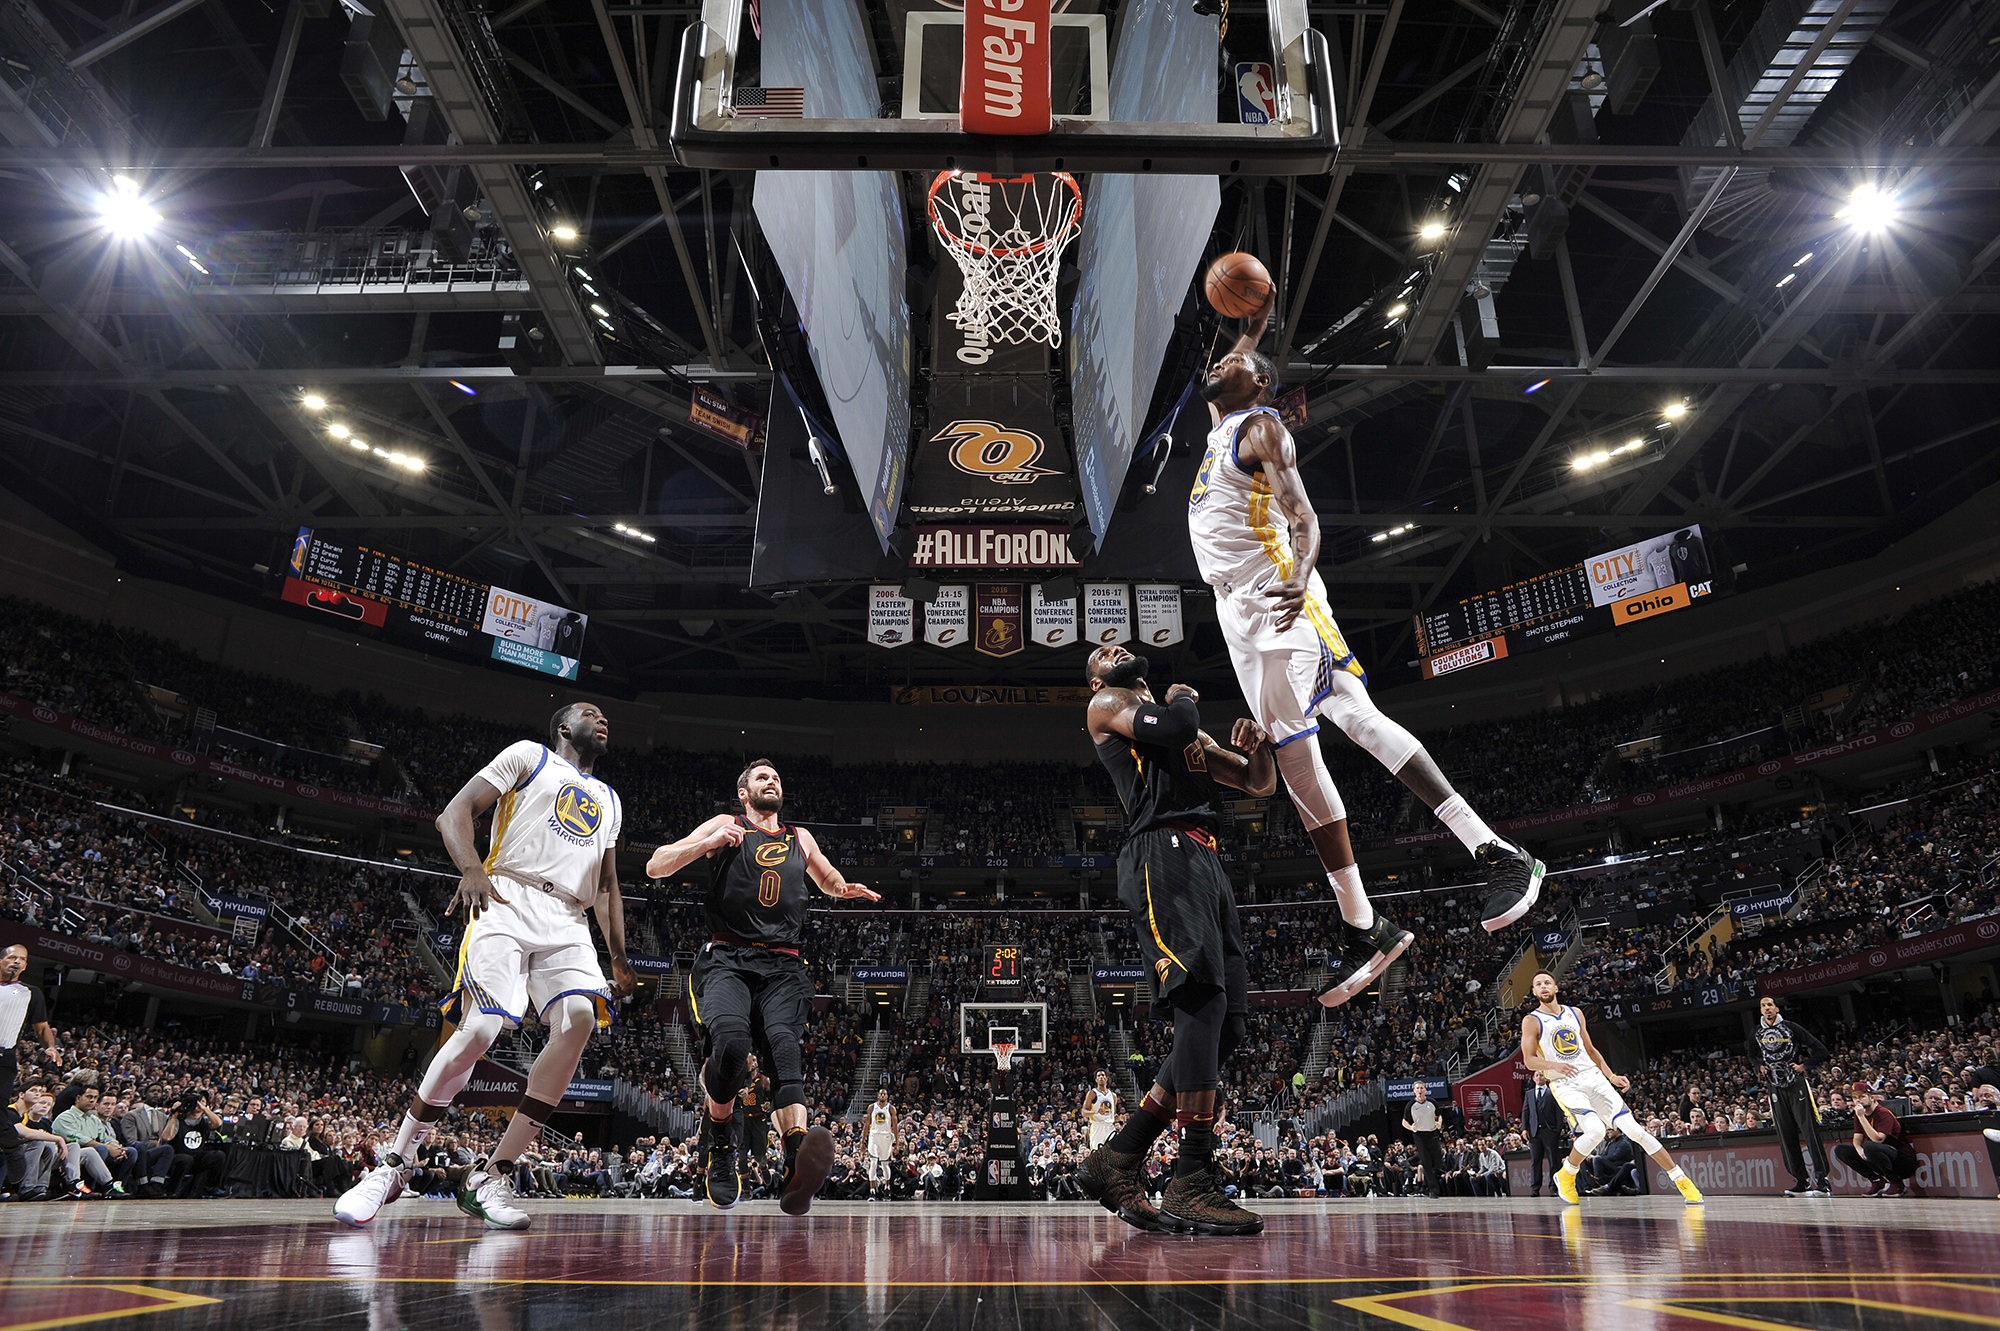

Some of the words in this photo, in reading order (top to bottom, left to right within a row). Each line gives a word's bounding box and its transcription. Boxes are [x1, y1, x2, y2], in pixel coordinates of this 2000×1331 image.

[1245, 112, 1264, 123] NBA
[695, 408, 711, 421] TEAM
[712, 417, 731, 430] SWISH
[996, 473, 1031, 482] The
[961, 498, 1027, 506] Arena
[910, 506, 975, 514] Loans
[982, 502, 1076, 514] Quicken
[323, 542, 344, 554] Durant
[322, 549, 340, 560] Green
[320, 556, 337, 567] Curry
[318, 562, 343, 575] Iguodala
[1592, 552, 1634, 584] CITY
[316, 568, 336, 580] McCaw
[305, 574, 320, 584] TEAM
[320, 578, 341, 590] TOTALS
[1602, 576, 1638, 592] COLLECTION
[990, 586, 1008, 594] 2016
[1092, 588, 1122, 596] 2016-17
[1689, 581, 1712, 598] CAT
[992, 598, 1006, 606] NBA
[1093, 599, 1122, 607] EASTERN
[1139, 594, 1178, 602] CHAMPIONS
[492, 594, 533, 623] CITY
[1039, 600, 1068, 608] EASTERN
[1626, 596, 1674, 616] Ohio
[870, 609, 912, 618] CONFERENCE
[926, 609, 966, 618] CONFERENCE
[980, 605, 1019, 615] CHAMPIONS
[1034, 608, 1074, 616] CONFERENCE
[1087, 608, 1128, 616] CONFERENCE
[410, 615, 434, 628] SHOTS
[436, 623, 469, 637] STEPHEN
[494, 618, 526, 632] COLLECTION
[872, 618, 910, 626] CHAMPIONS
[928, 618, 965, 626] CHAMPIONS
[1036, 616, 1073, 626] CHAMPIONS
[1089, 616, 1126, 625] CHAMPIONS
[1525, 628, 1549, 638] SHOTS
[1550, 615, 1584, 630] STEPHEN
[424, 630, 450, 643] CURRY.
[1544, 631, 1571, 643] CURRY.
[500, 640, 522, 653] BUILD
[523, 646, 544, 658] MORE
[1432, 642, 1487, 667] COUNTERTOP
[498, 646, 517, 658] THAN
[518, 651, 544, 666] MUSCLE
[1438, 652, 1483, 672] SOLUTIONS
[930, 688, 1050, 705] LOUDVILLE
[1928, 710, 1951, 725] Visit
[1952, 701, 1976, 718] Your
[70, 719, 156, 755] kiadealers.com
[208, 761, 285, 789] SORENTO
[332, 792, 352, 804] Visit
[356, 796, 375, 809] Your
[378, 802, 401, 814] Local
[403, 806, 417, 817] Kia
[1394, 832, 1456, 845] SORENT
[1508, 818, 1526, 830] Visit
[1528, 814, 1548, 828] Your
[1550, 809, 1573, 822] Local
[1575, 807, 1589, 817] Kia
[1591, 801, 1620, 815] Dealer
[1668, 771, 1745, 799] kiadealers.com
[1794, 734, 1877, 764] SORENTO
[579, 797, 598, 817] 23
[548, 816, 594, 848] WARRIORS
[1370, 840, 1389, 848] Final
[1241, 852, 1248, 860] 6
[1283, 850, 1294, 858] PM
[840, 858, 858, 867] FG%
[863, 858, 875, 866] 65
[920, 857, 934, 868] 34
[960, 858, 971, 867] 21
[986, 858, 1008, 867] 2:02
[1081, 858, 1095, 868] 29
[758, 869, 781, 908] 0
[224, 901, 266, 916] HYUNDAI
[1750, 896, 1793, 911] HYUNDAI
[1542, 942, 1567, 950] HYUNDAI
[995, 948, 1017, 959] 2:02
[37, 936, 104, 962] SORENTO
[140, 962, 155, 977] Visit
[157, 966, 172, 980] Your
[174, 968, 194, 986] Local
[196, 974, 208, 988] Kia
[210, 978, 236, 993] Dealer
[634, 959, 670, 969] HYUNDAI
[1764, 977, 1783, 990] Visit
[1784, 975, 1804, 987] Your
[1804, 968, 1825, 982] Local
[1826, 966, 1838, 977] Kia
[1838, 960, 1860, 975] Dealer
[1896, 932, 1966, 960] kiadealers.com
[992, 958, 1015, 977] 21
[1749, 986, 1756, 997] 5
[242, 990, 253, 1000] 65
[288, 992, 296, 1008] 5
[314, 999, 363, 1016] REBOUNDS
[382, 1007, 391, 1021] 7
[1604, 1004, 1622, 1020] 34
[1652, 1000, 1673, 1010] 2:02
[1682, 996, 1692, 1005] 21
[1702, 988, 1719, 1006] 29
[426, 1017, 437, 1028] 63
[1564, 1032, 1575, 1041] 30
[580, 1083, 613, 1091] MORTGAGE
[1392, 1090, 1414, 1098] Quicken
[1000, 1112, 1010, 1120] NBA
[1000, 1160, 1010, 1168] THIS
[1011, 1160, 1016, 1168] IS
[1680, 1152, 1776, 1189] StateFarm
[1000, 1176, 1007, 1184] WE
[1007, 1176, 1018, 1184] PLAY
